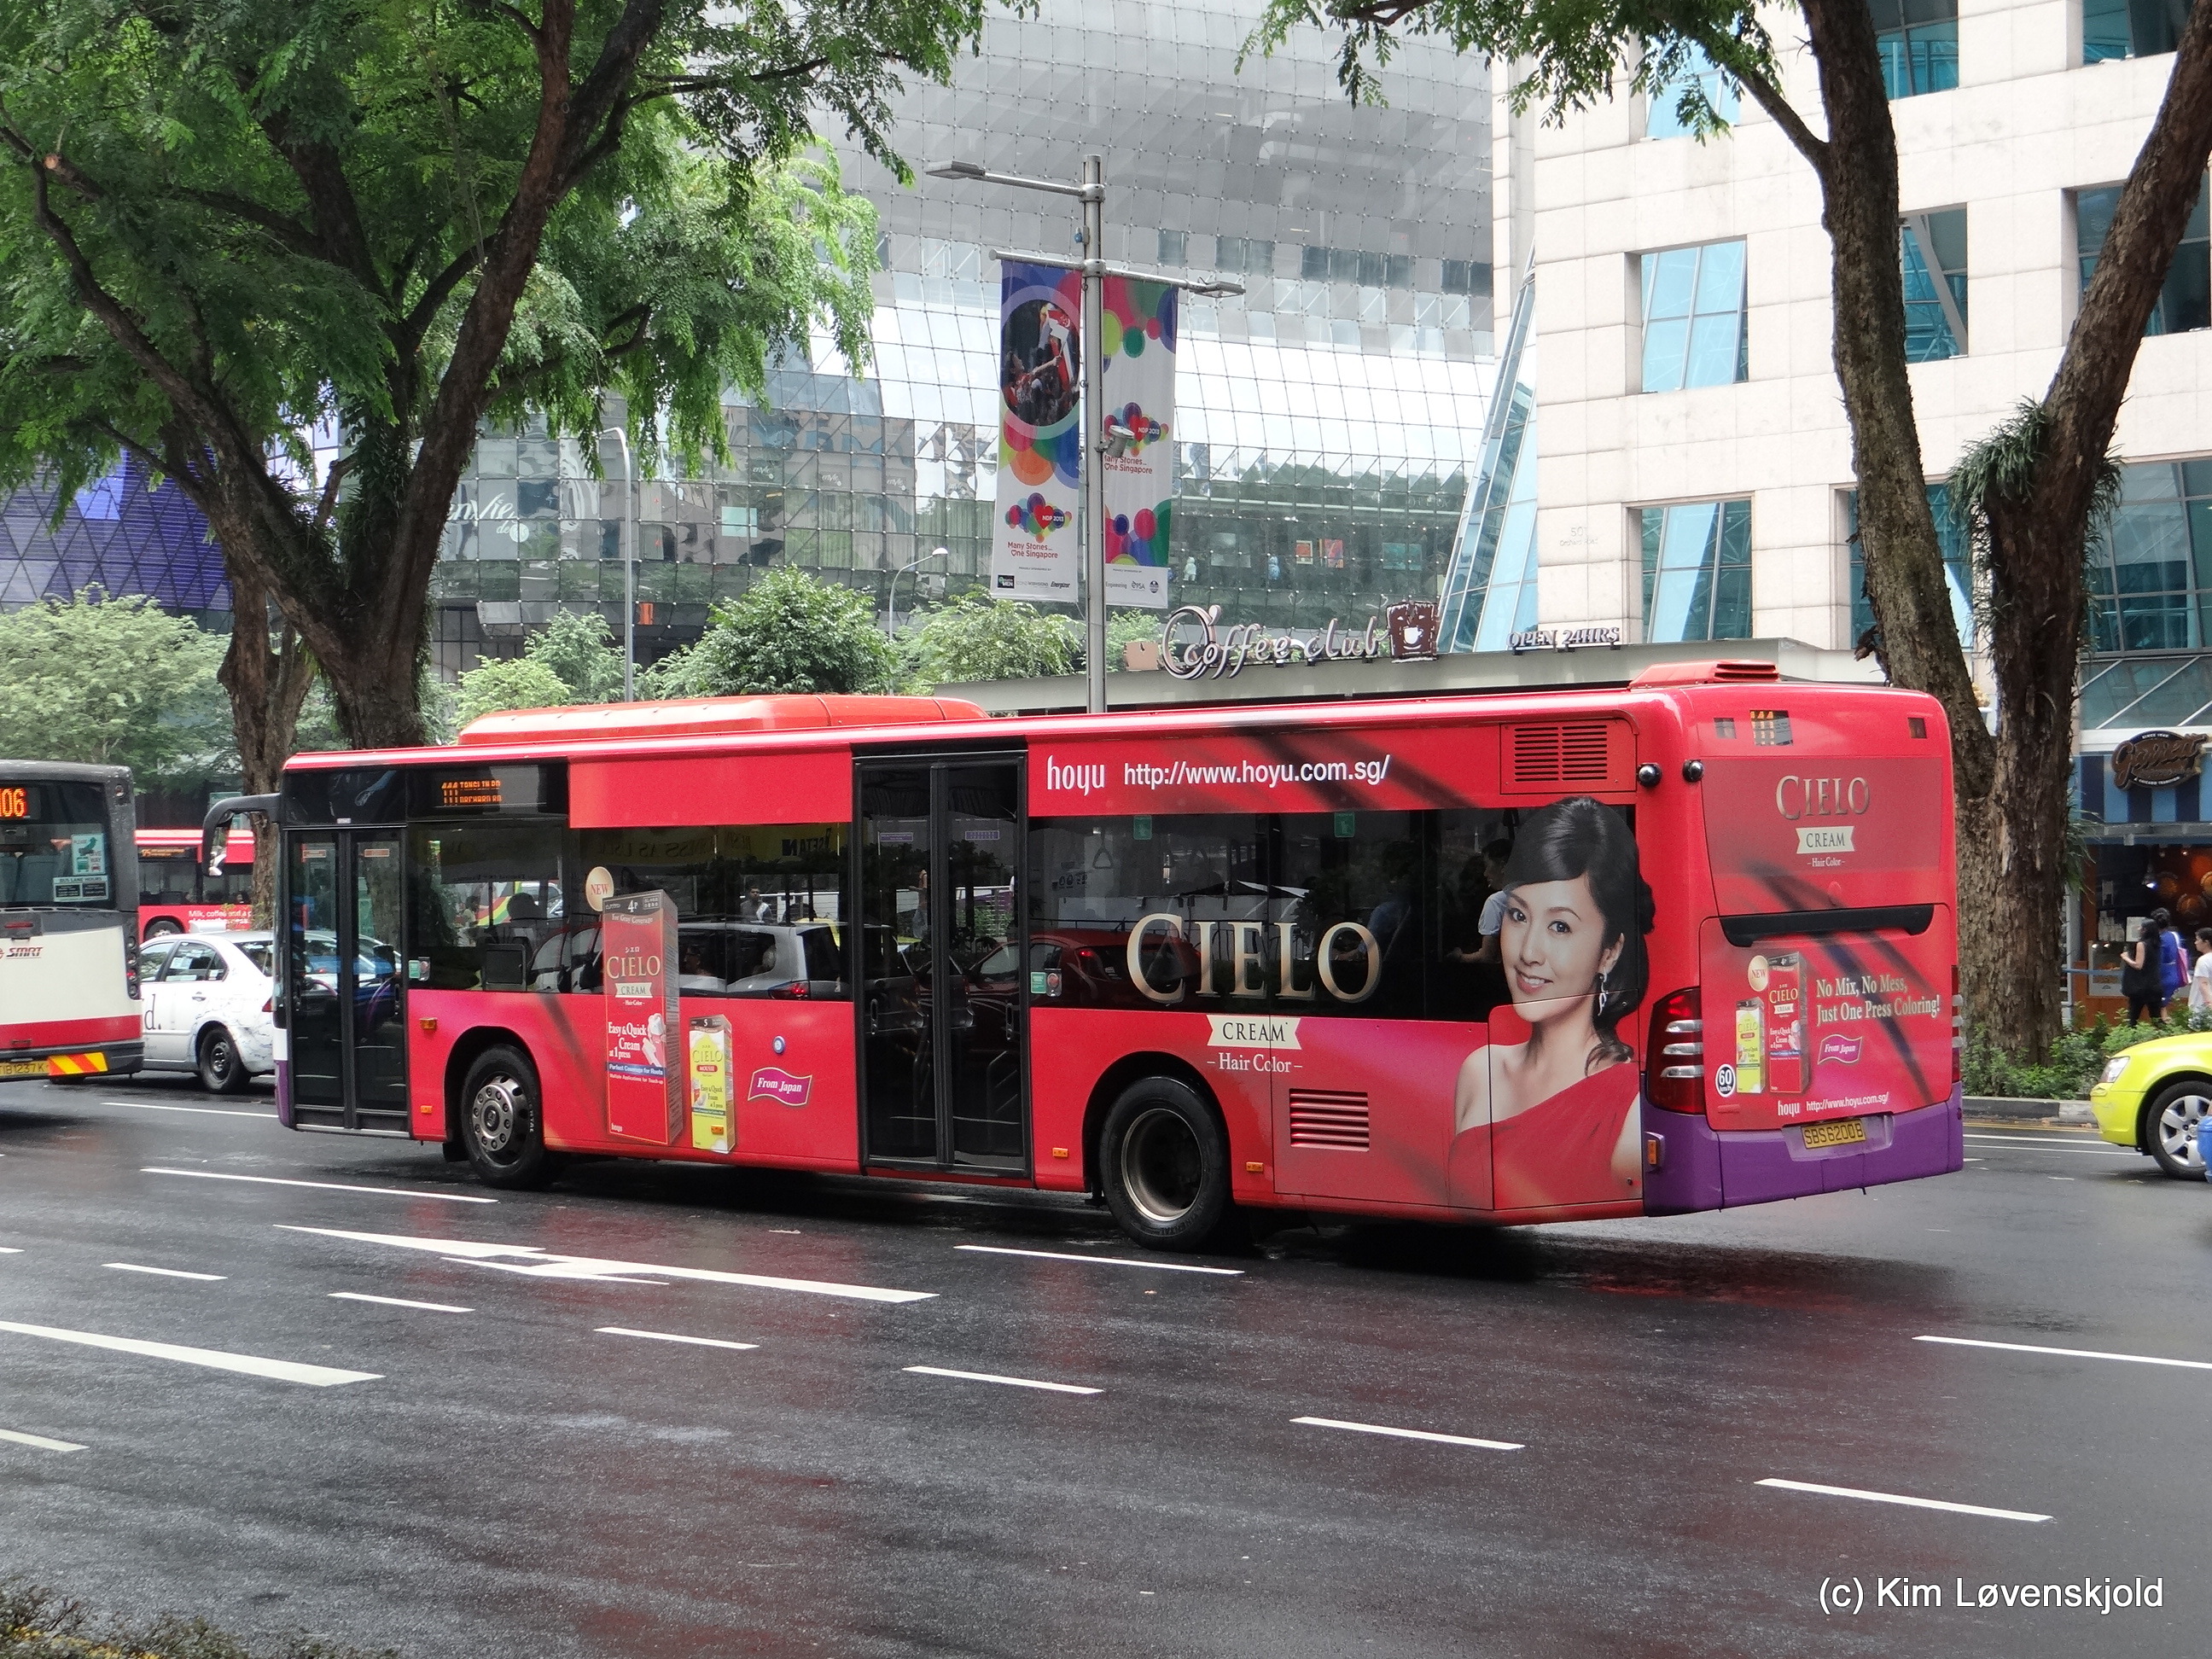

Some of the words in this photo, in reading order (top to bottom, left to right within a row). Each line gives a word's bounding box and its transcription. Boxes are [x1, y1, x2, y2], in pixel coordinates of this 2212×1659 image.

[1120, 464, 1153, 474] Singapore
[1007, 541, 1025, 550] Many
[1026, 550, 1058, 559] Singapore
[1506, 630, 1558, 649] OPEN
[1562, 627, 1621, 645] 24HRS
[1047, 754, 1105, 796] hoyu
[1124, 754, 1391, 791] http://www.hoyu.com.sg/
[0, 789, 26, 817] 06
[1775, 775, 1870, 821] CIELO
[1806, 832, 1845, 848] CREAM
[1812, 858, 1825, 867] Hair
[1825, 857, 1842, 867] Color
[591, 883, 609, 895] NEW
[6, 946, 44, 958] SMRT
[1126, 912, 1382, 1004] CIELO
[606, 955, 661, 979] CIELO
[1751, 969, 1766, 979] NEW
[621, 986, 646, 996] CREAM
[1816, 980, 1832, 998] No
[1836, 977, 1860, 997] Mix,
[1861, 975, 1877, 994] No
[1880, 974, 1907, 993] Mess,
[1769, 988, 1798, 1004] CIELO
[1816, 1004, 1837, 1027] Just
[1840, 1002, 1862, 1021] One
[1865, 1000, 1891, 1018] Press
[1894, 994, 1940, 1018] Coloring!
[1222, 1022, 1285, 1042] CREAM
[619, 1038, 640, 1051] Cream
[1825, 1044, 1839, 1053] From
[1839, 1045, 1856, 1055] Japan
[692, 1050, 723, 1063] CIELO
[1218, 1052, 1250, 1071] Hair
[1253, 1054, 1291, 1074] Color
[0, 1062, 44, 1074] IB1237K
[1718, 1068, 1732, 1086] 60
[757, 1077, 777, 1088] From
[779, 1080, 802, 1094] Japan
[1778, 1099, 1800, 1117] hoyu
[1806, 1091, 1889, 1112] http://www.hoyu.com.sg/
[1804, 1122, 1864, 1145] SBS6200B
